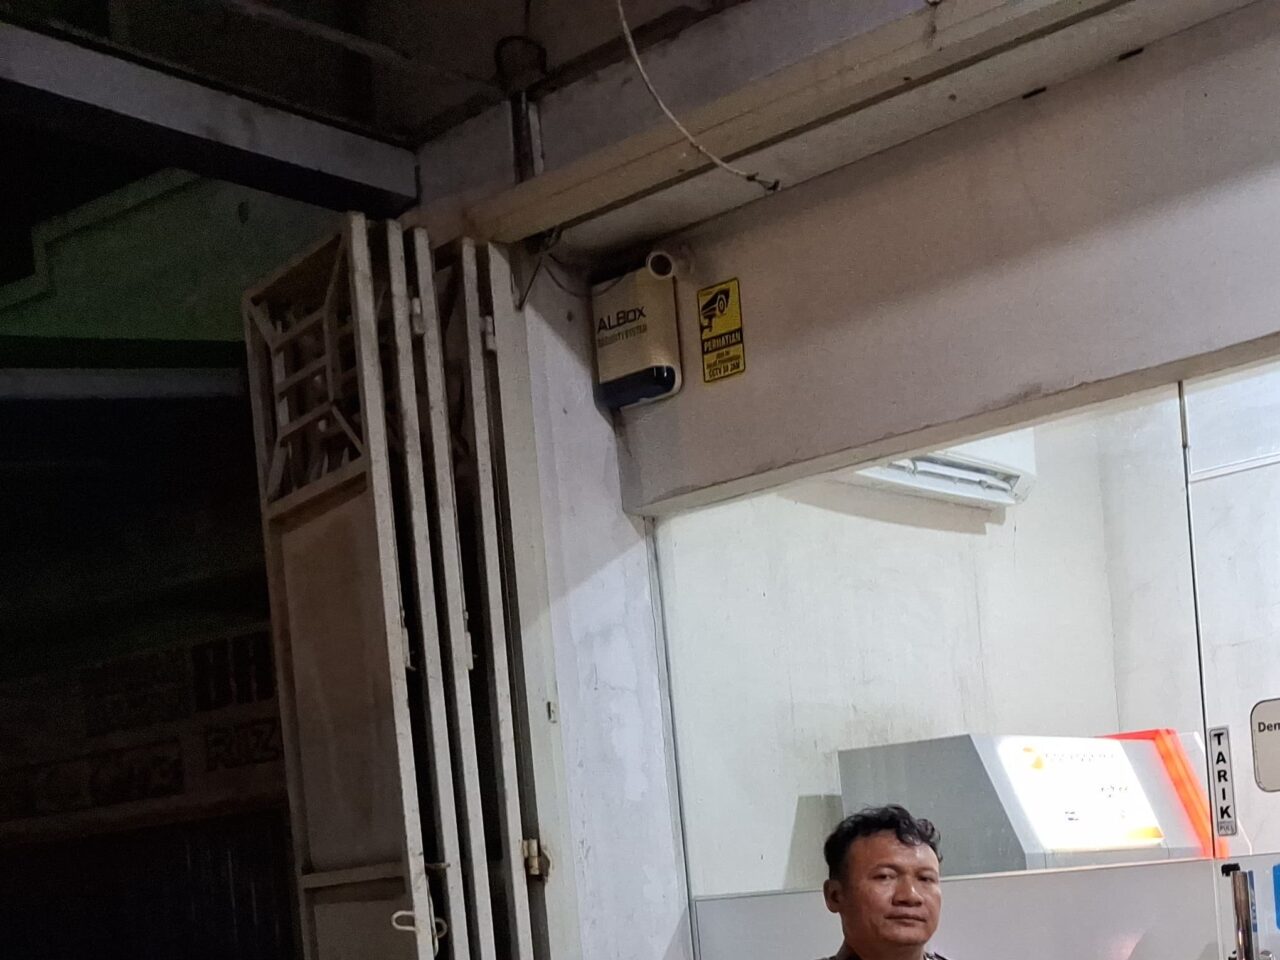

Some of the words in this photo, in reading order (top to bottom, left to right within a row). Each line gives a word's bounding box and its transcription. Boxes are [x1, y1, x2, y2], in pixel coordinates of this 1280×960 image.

[597, 306, 647, 334] ALBOX
[703, 331, 741, 353] PERHATIAN
[1213, 732, 1233, 819] TARIK
